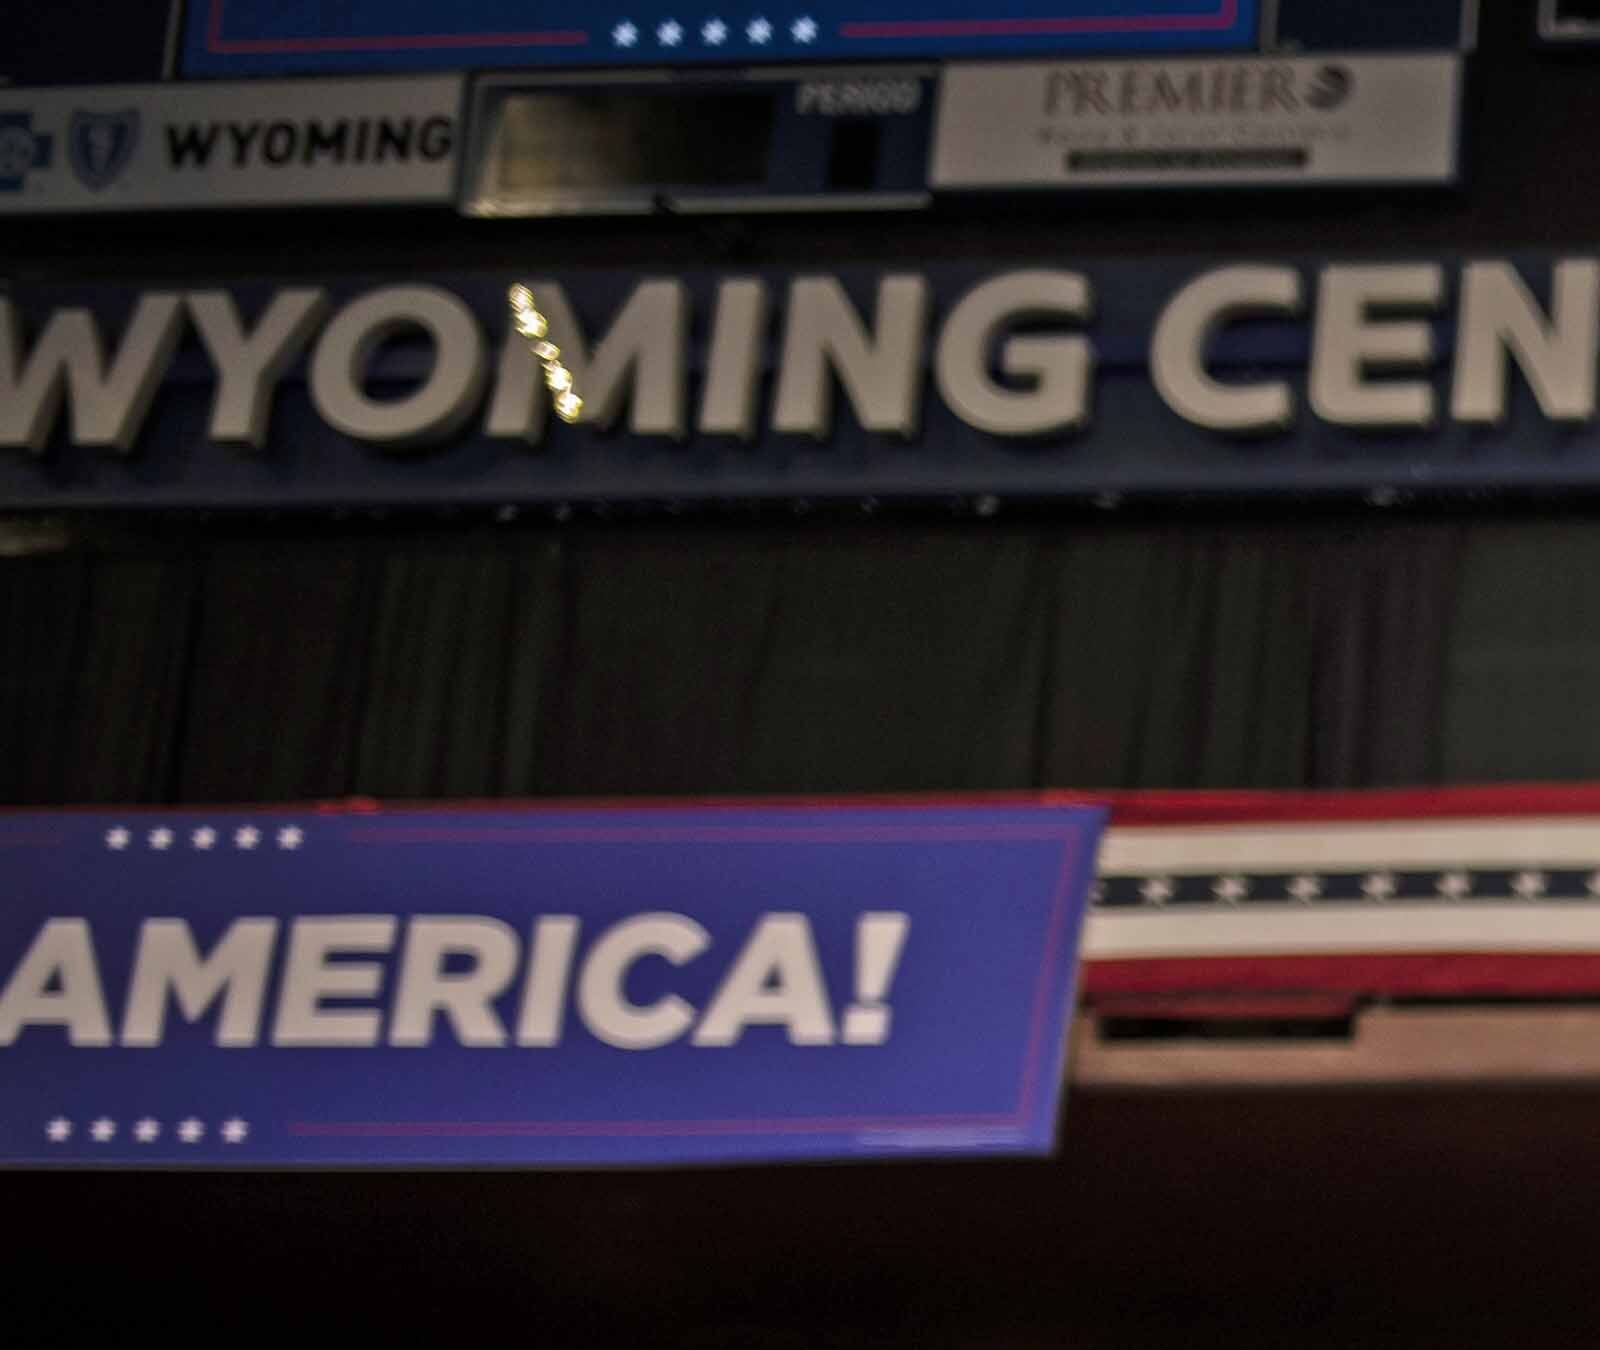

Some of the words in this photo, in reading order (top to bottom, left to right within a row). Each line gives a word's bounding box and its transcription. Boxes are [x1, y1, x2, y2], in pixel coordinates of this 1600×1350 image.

[1042, 65, 1302, 114] PREMIER
[164, 115, 453, 170] WYOMING
[0, 268, 1090, 448] WYOMING
[0, 912, 910, 1050] AMERICA!
